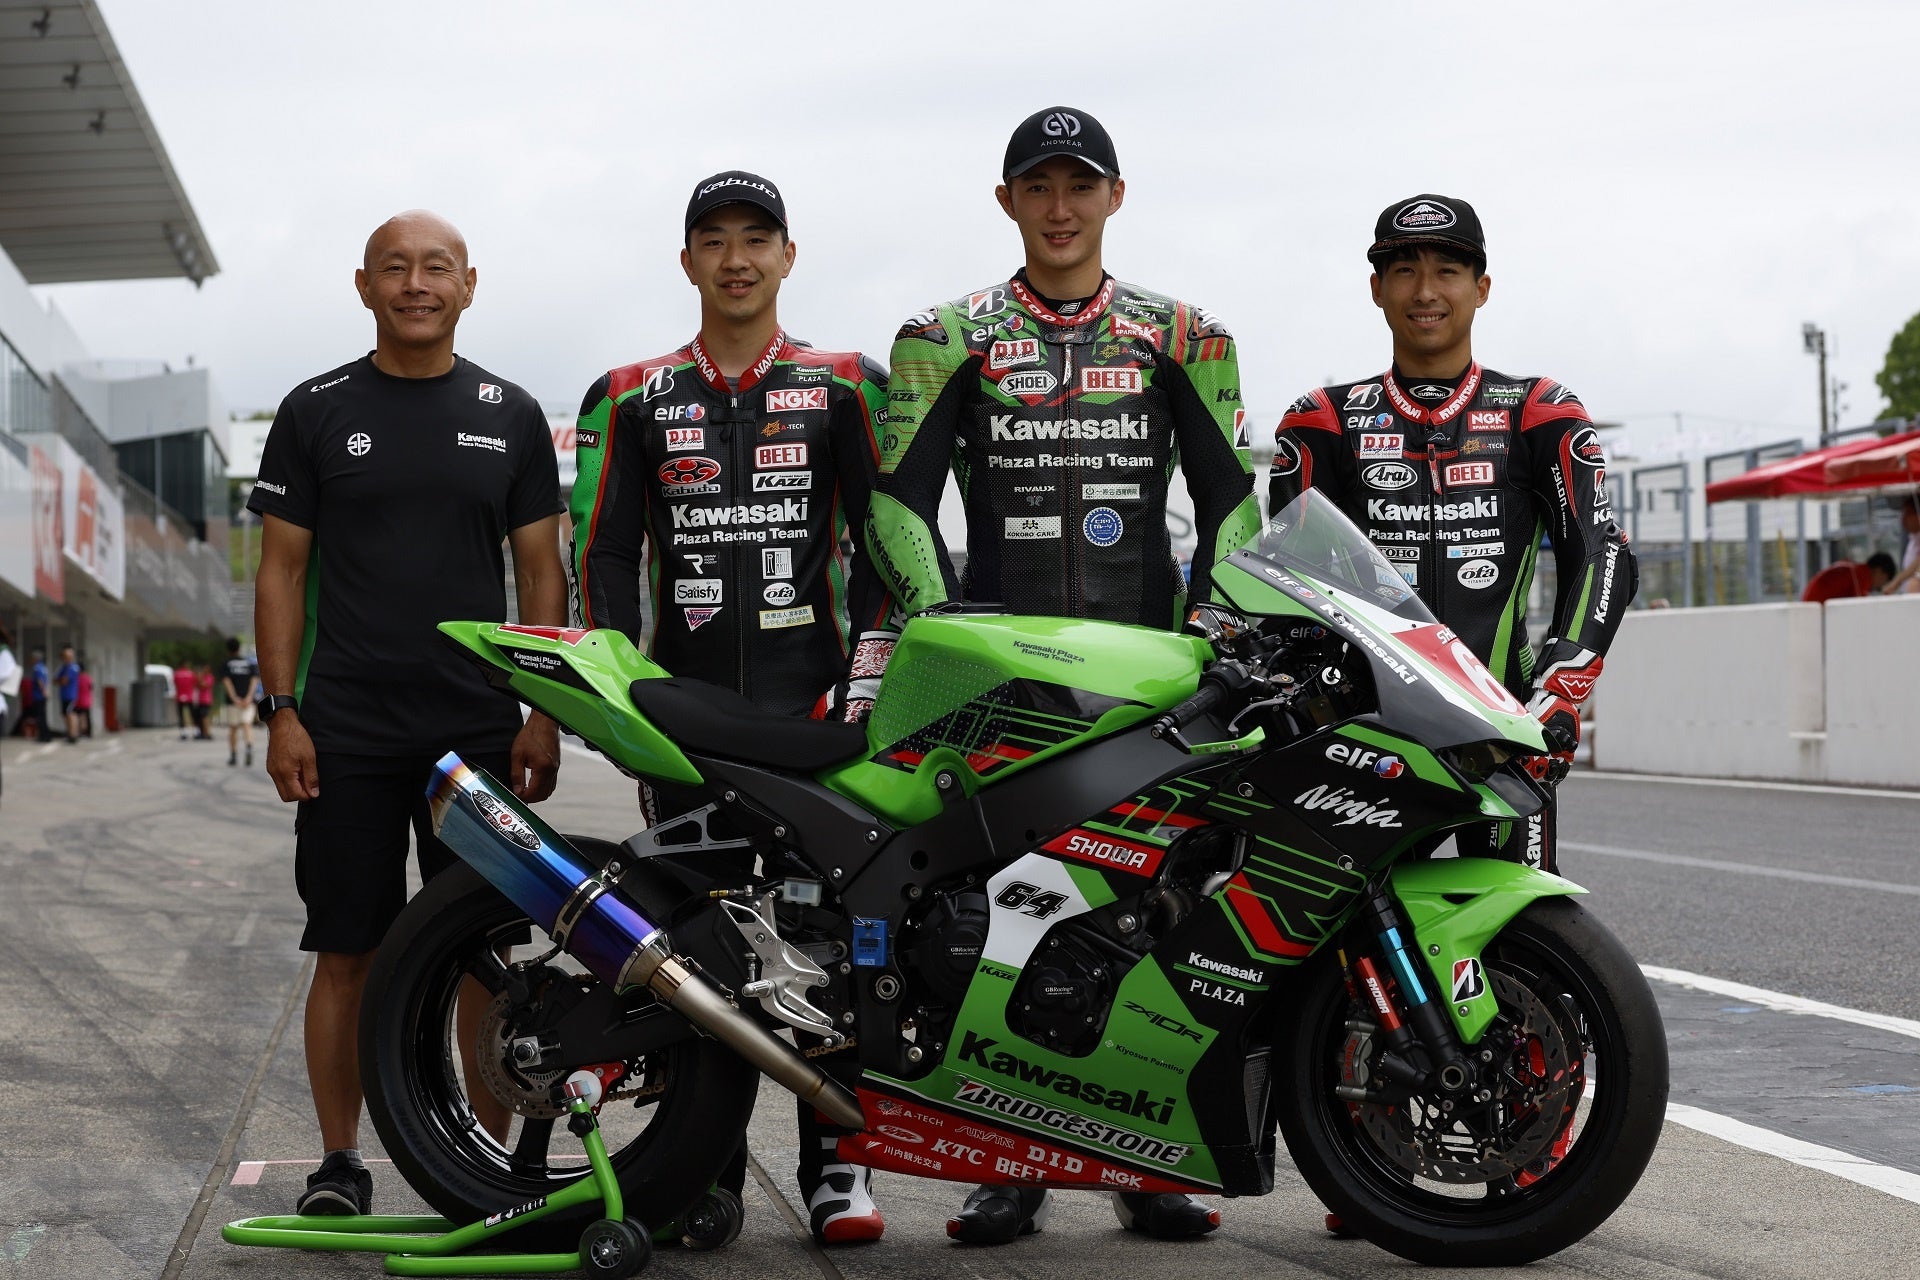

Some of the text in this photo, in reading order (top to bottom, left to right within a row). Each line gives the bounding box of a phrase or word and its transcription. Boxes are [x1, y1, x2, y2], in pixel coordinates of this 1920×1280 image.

[698, 178, 776, 200] Kabuto
[1013, 282, 1056, 321] HYOD
[1121, 296, 1165, 308] Kawasaki
[1125, 306, 1157, 320] PLAZA
[691, 340, 717, 382] NANKAI
[753, 333, 785, 378] NANKAI
[1007, 376, 1047, 391] SHOEI
[1086, 371, 1139, 389] BEET
[769, 390, 817, 409] NGK
[888, 393, 921, 402] AZE
[655, 406, 685, 420] elf
[1347, 416, 1375, 428] elf
[1472, 412, 1505, 425] NGK
[990, 414, 1148, 441] Kawasaki
[458, 433, 506, 448] Kawasaki
[760, 447, 803, 464] BEET
[988, 453, 1154, 469] Plaza Racing Team
[755, 475, 809, 488] KAZE
[1367, 466, 1411, 481] Arai
[1450, 465, 1489, 482] BEET
[663, 484, 720, 496] Kabuto
[671, 497, 808, 528] Kawasaki
[1368, 496, 1498, 521] Kawasaki
[674, 527, 808, 546] Plaza Racing Team
[1369, 526, 1500, 542] Plaza Racing Team
[866, 507, 920, 604] Kawasaki
[1462, 546, 1503, 556] テクノエース
[1264, 568, 1299, 587] elf
[1461, 565, 1495, 579] ofa
[766, 587, 793, 598] ofa
[1594, 542, 1620, 624] Kawasaki
[677, 585, 719, 601] Satisfy
[1291, 627, 1311, 638] elf
[1013, 640, 1085, 662] Kawasaki Plaza
[1320, 603, 1419, 684] Kawasaki
[514, 651, 561, 666] Kawasaki Plaza
[520, 660, 538, 668] Racing
[1022, 648, 1072, 664] Racing Team
[1325, 743, 1377, 769] elf
[1294, 784, 1402, 828] Ninja
[474, 792, 503, 816] BEET
[501, 814, 538, 846] JAPAN
[1066, 835, 1147, 869] SHOWA
[995, 881, 1069, 920] 64
[979, 965, 1017, 981] KAZE
[1188, 952, 1263, 984] Kawasaki
[1189, 979, 1246, 1006] PLAZA
[1366, 977, 1390, 1014] SHOWA
[1115, 1044, 1184, 1075] Kiyosue Painting
[958, 1029, 1177, 1126] Kawasaki
[904, 1111, 944, 1127] A-TECH
[955, 1082, 1185, 1165] BRIDGESTONE
[884, 1145, 942, 1171] 川内観光交通
[931, 1138, 986, 1165] KTC
[1027, 1145, 1083, 1174] D.I.D
[995, 1156, 1047, 1182] BEET
[1101, 1167, 1143, 1188] NGK
